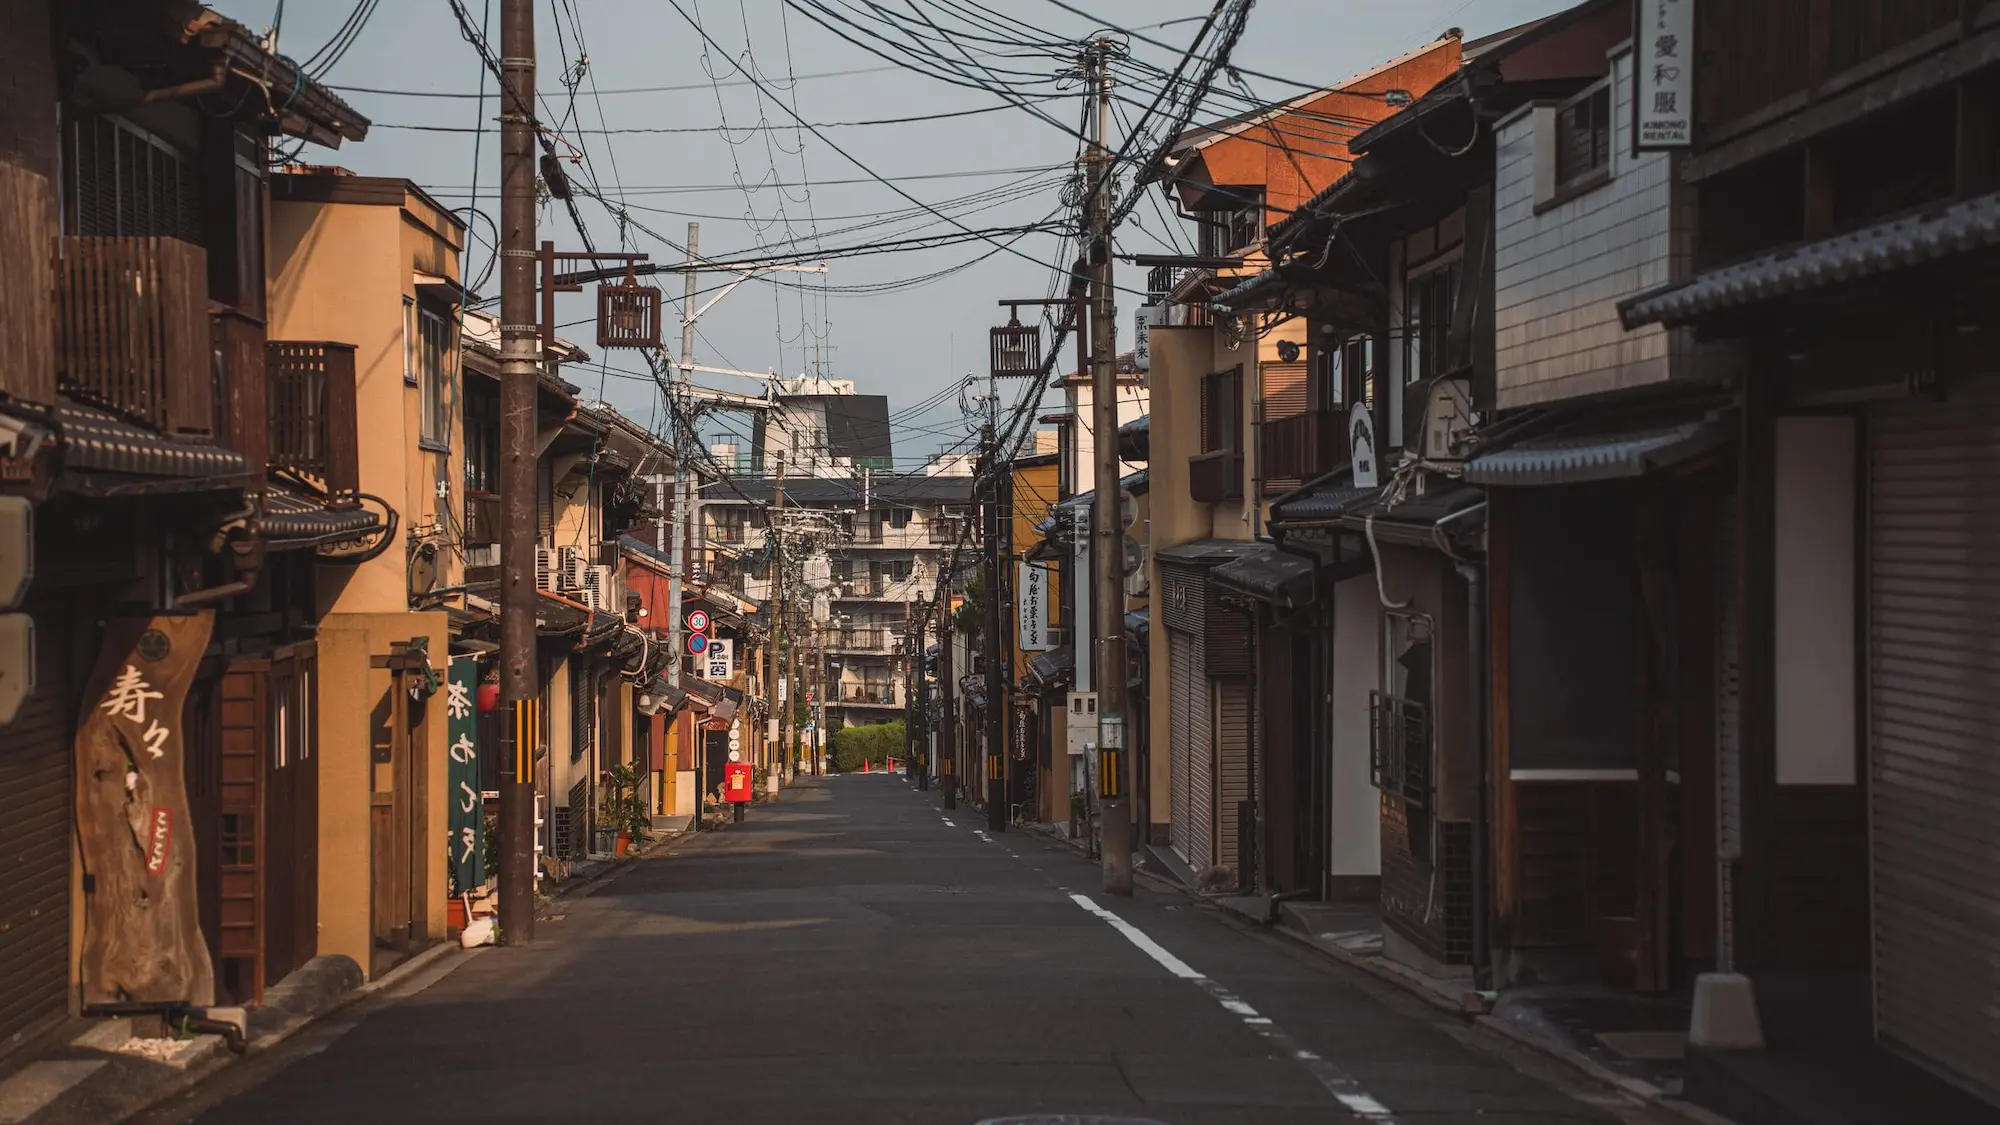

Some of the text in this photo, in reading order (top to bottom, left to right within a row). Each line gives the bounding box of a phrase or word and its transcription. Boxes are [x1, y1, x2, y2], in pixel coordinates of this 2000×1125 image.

[1643, 119, 1687, 130] KIMONO
[1643, 131, 1685, 141] RENTAL
[693, 617, 705, 627] 30
[709, 642, 726, 660] P
[100, 664, 170, 760] 寿々
